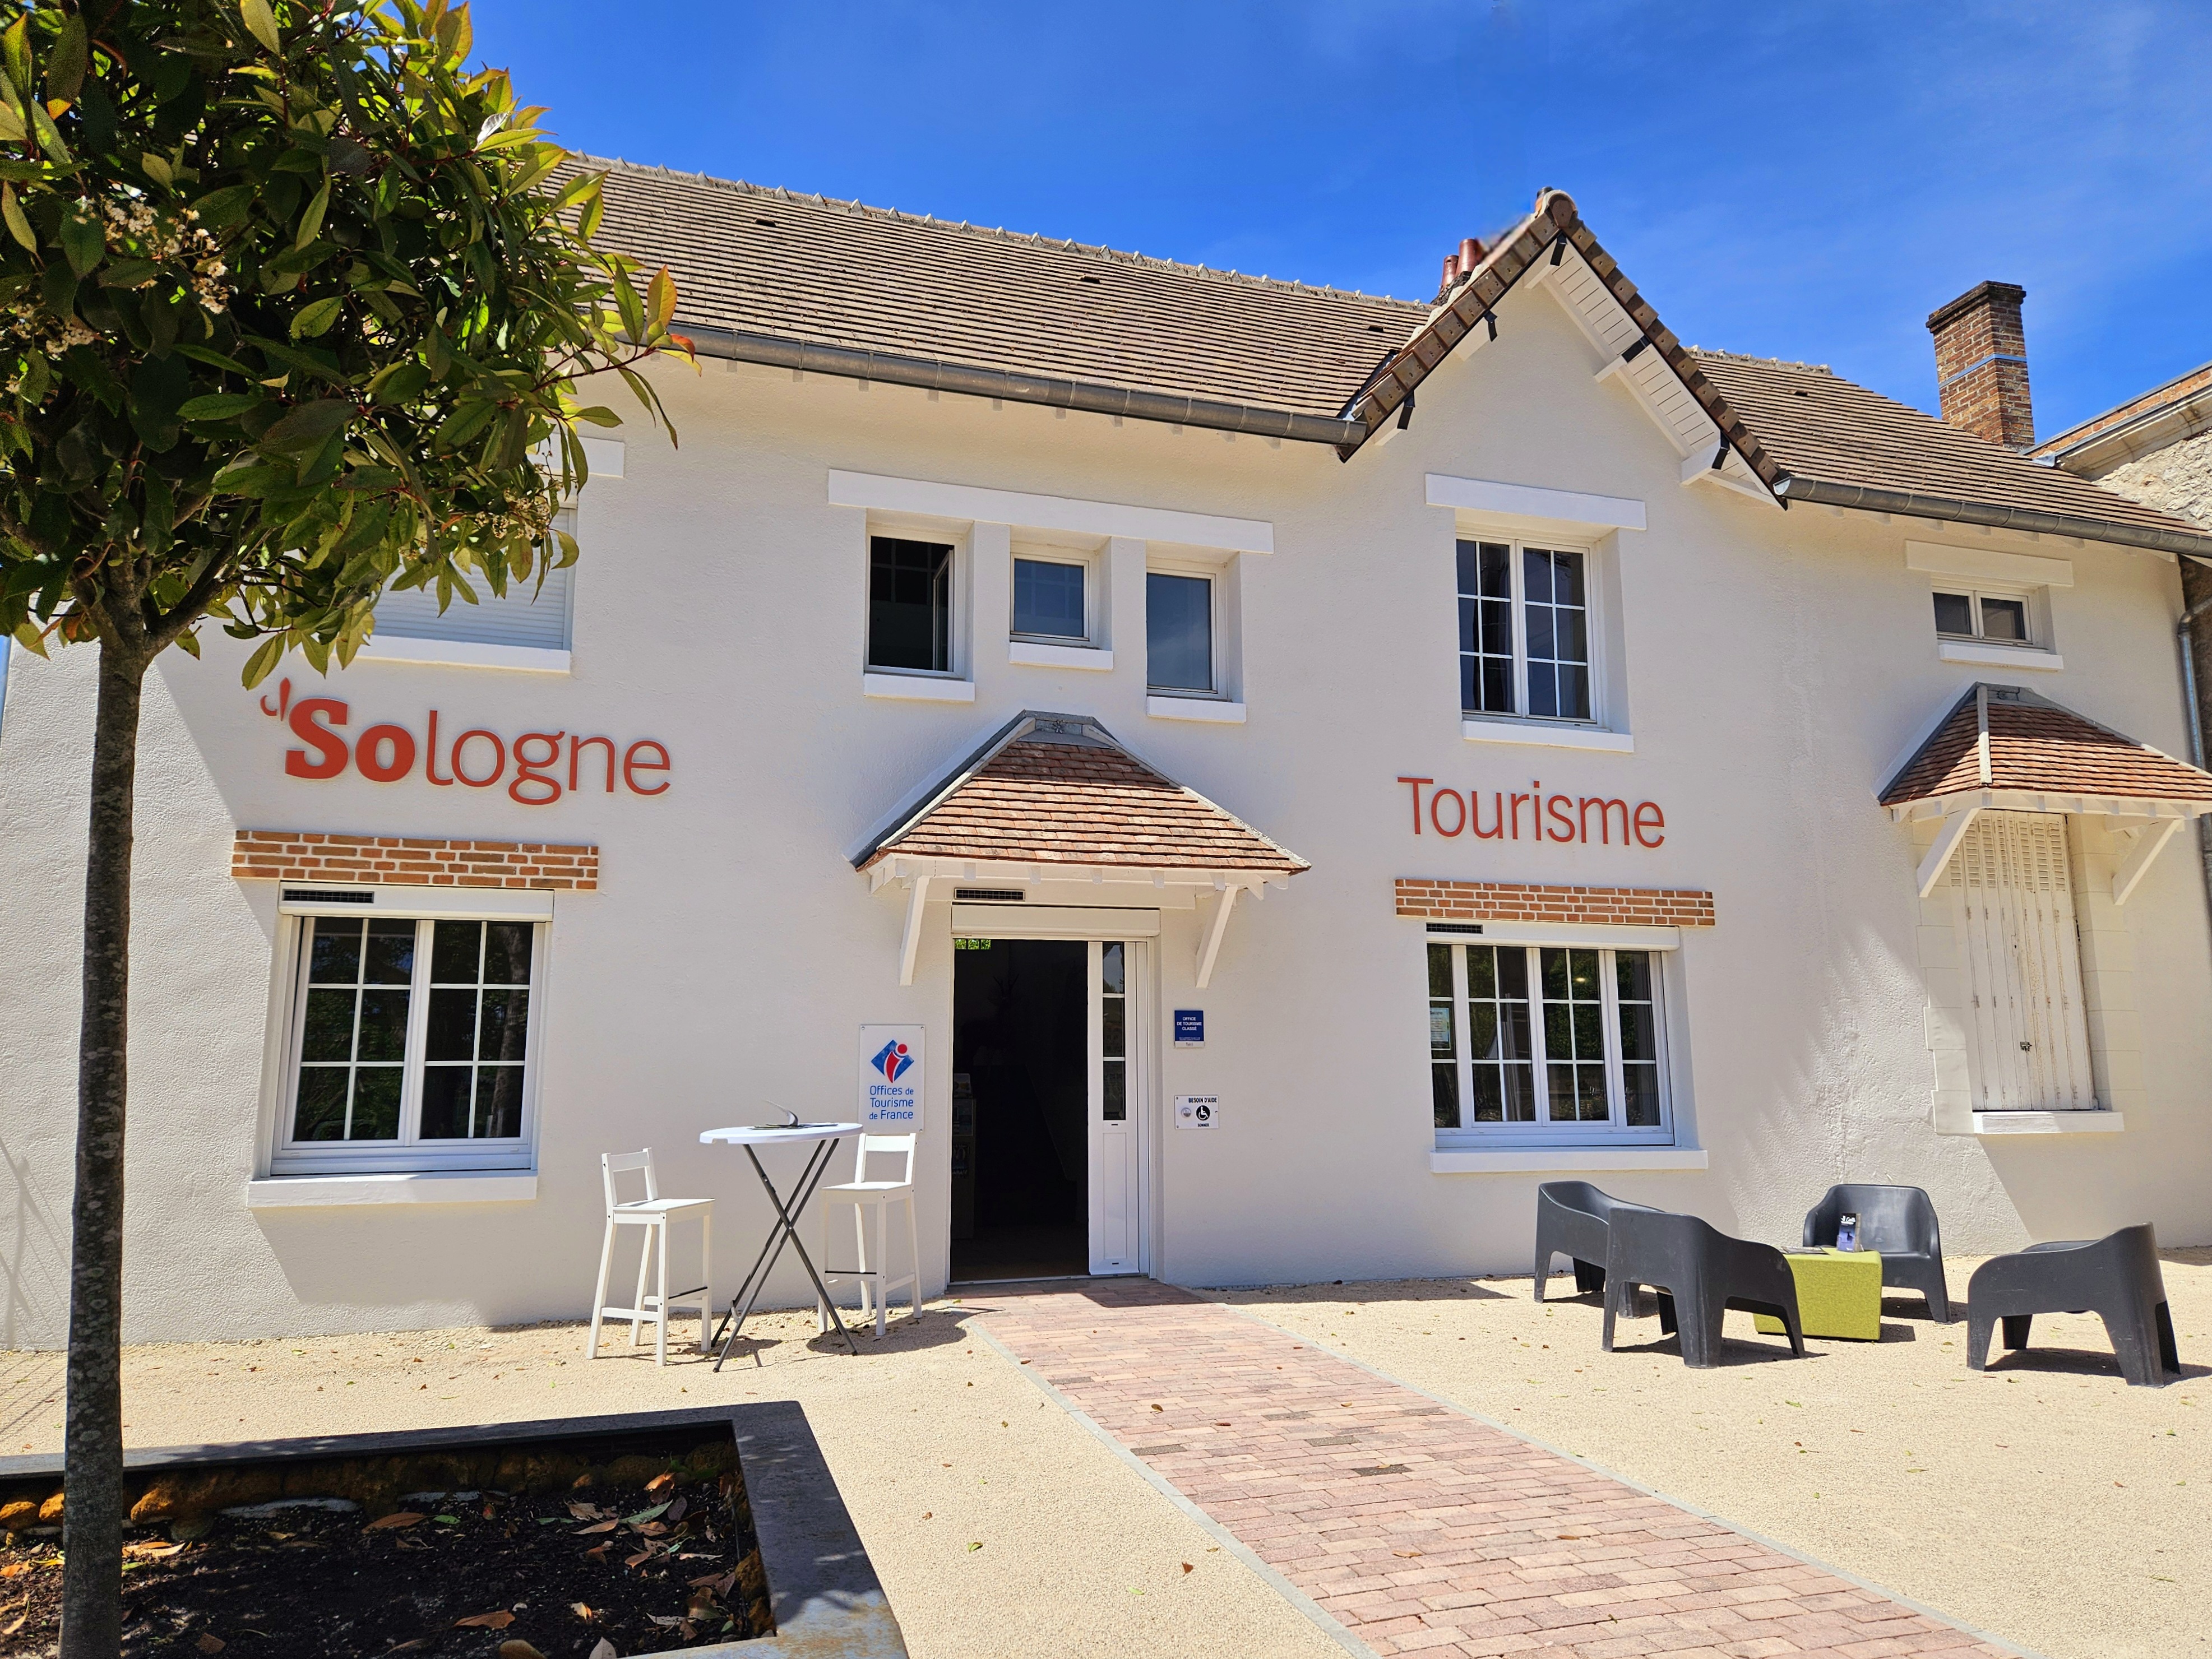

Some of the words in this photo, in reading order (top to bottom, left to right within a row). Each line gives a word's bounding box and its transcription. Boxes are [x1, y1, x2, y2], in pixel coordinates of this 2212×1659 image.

[285, 697, 672, 806] Sologne
[1397, 776, 1665, 849] Tourisme
[869, 1085, 903, 1095] Offices
[869, 1097, 914, 1107] Tourisme
[881, 1109, 914, 1120] France
